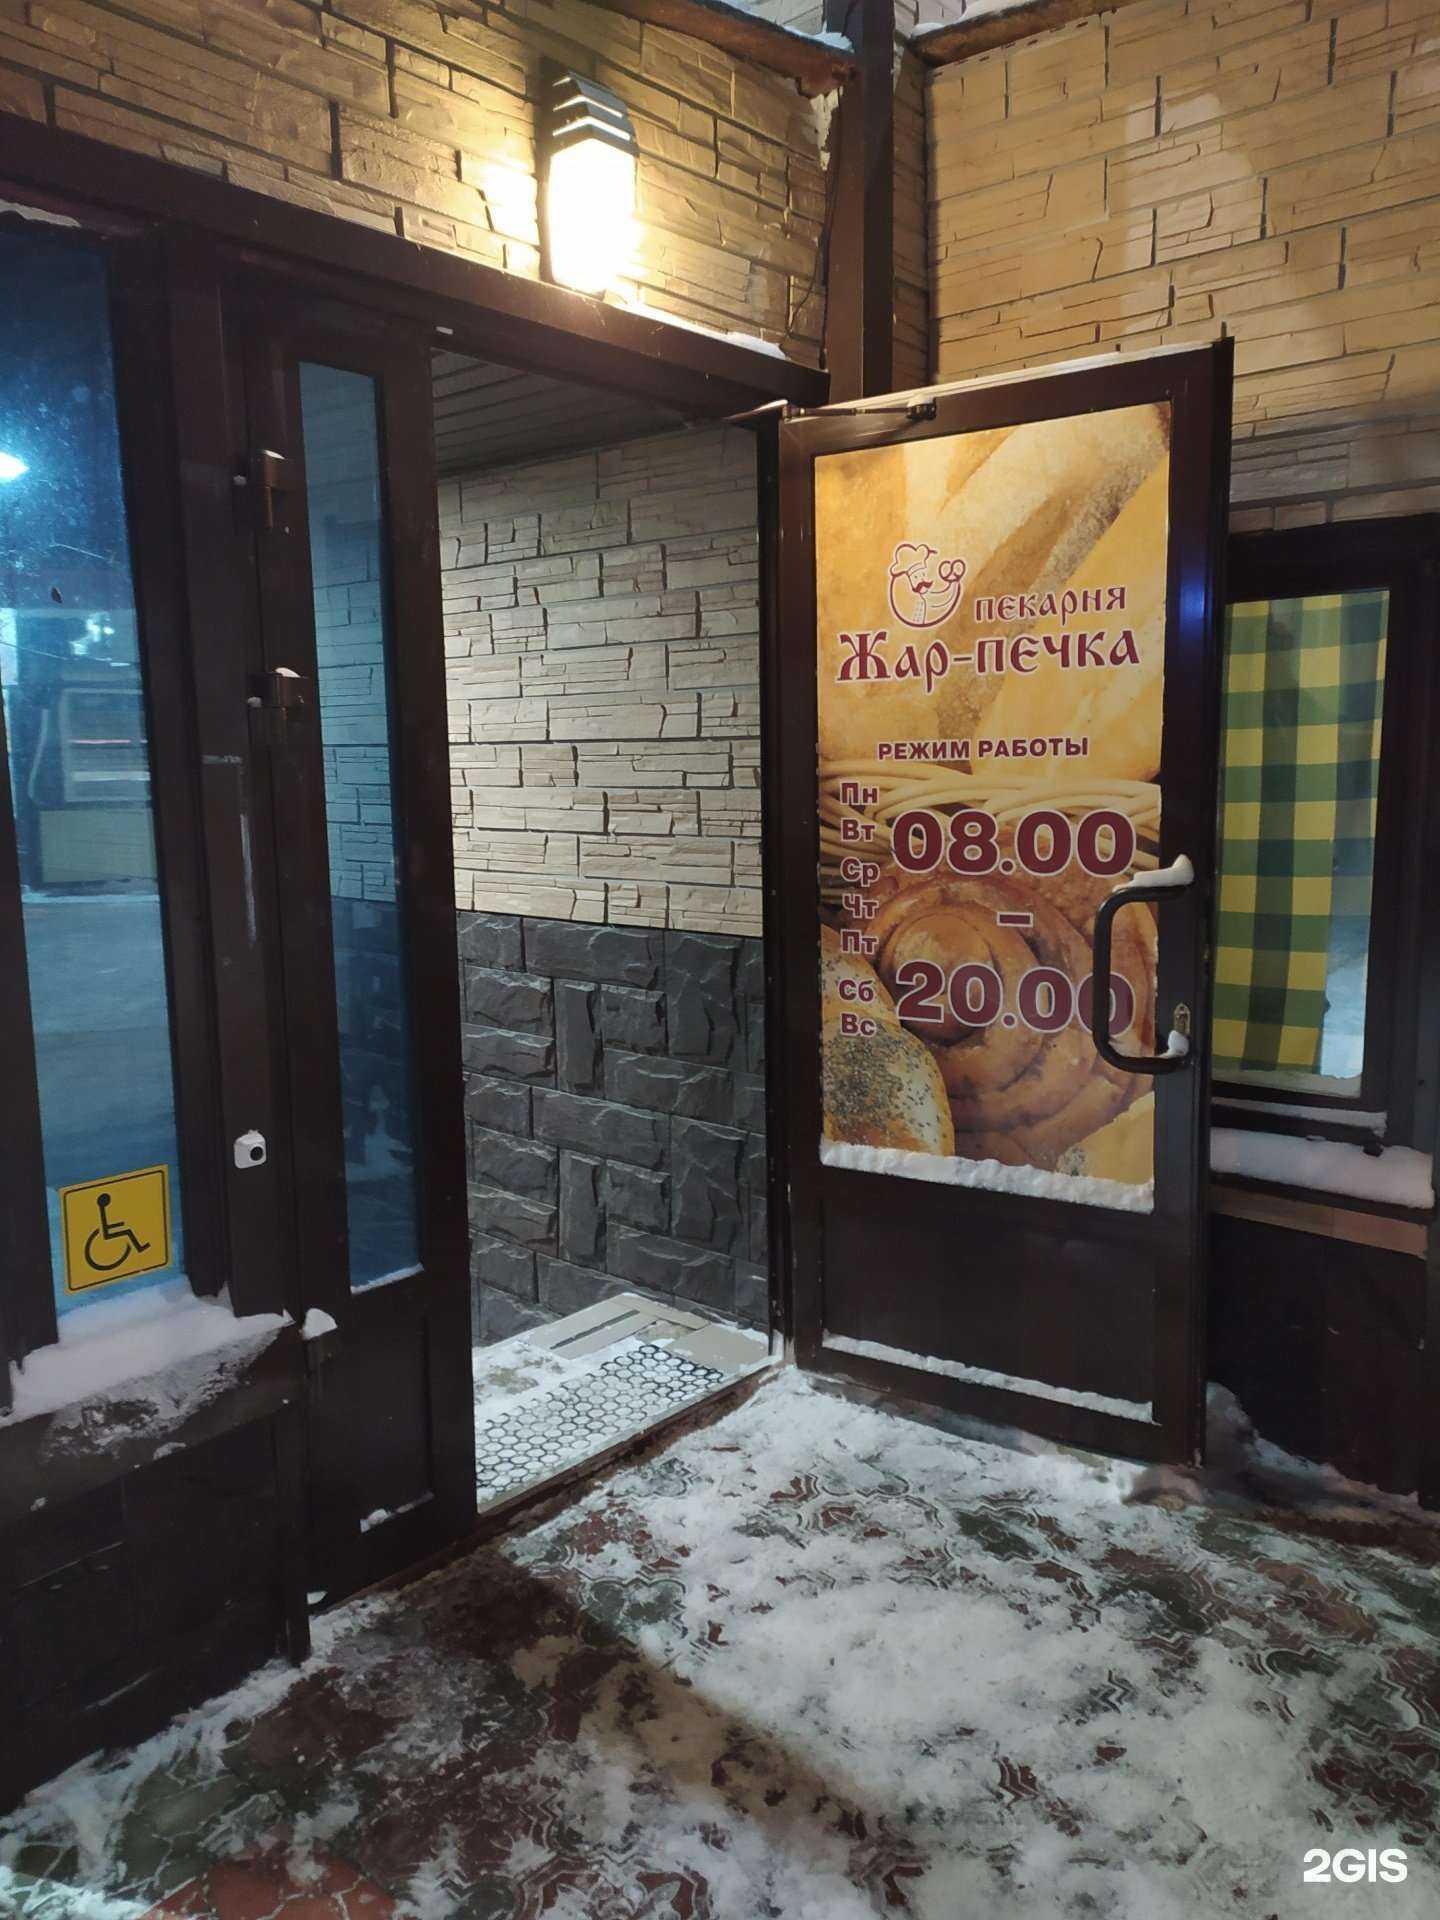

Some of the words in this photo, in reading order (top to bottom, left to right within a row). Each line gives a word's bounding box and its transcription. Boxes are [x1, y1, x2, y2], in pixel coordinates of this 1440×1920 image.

[837, 630, 1140, 692] Жар-печка
[878, 740, 971, 760] РЕЖИМ
[977, 737, 1088, 759] РАБОТЫ
[841, 782, 878, 804] Пн
[841, 819, 875, 841] Вт
[893, 810, 1136, 876] 08.00
[841, 857, 879, 886] Ср
[842, 895, 878, 918] Чт
[841, 931, 878, 952] Пт
[839, 979, 874, 1001] Сб
[896, 960, 1135, 1035] 20.00
[841, 1013, 876, 1037] Вс
